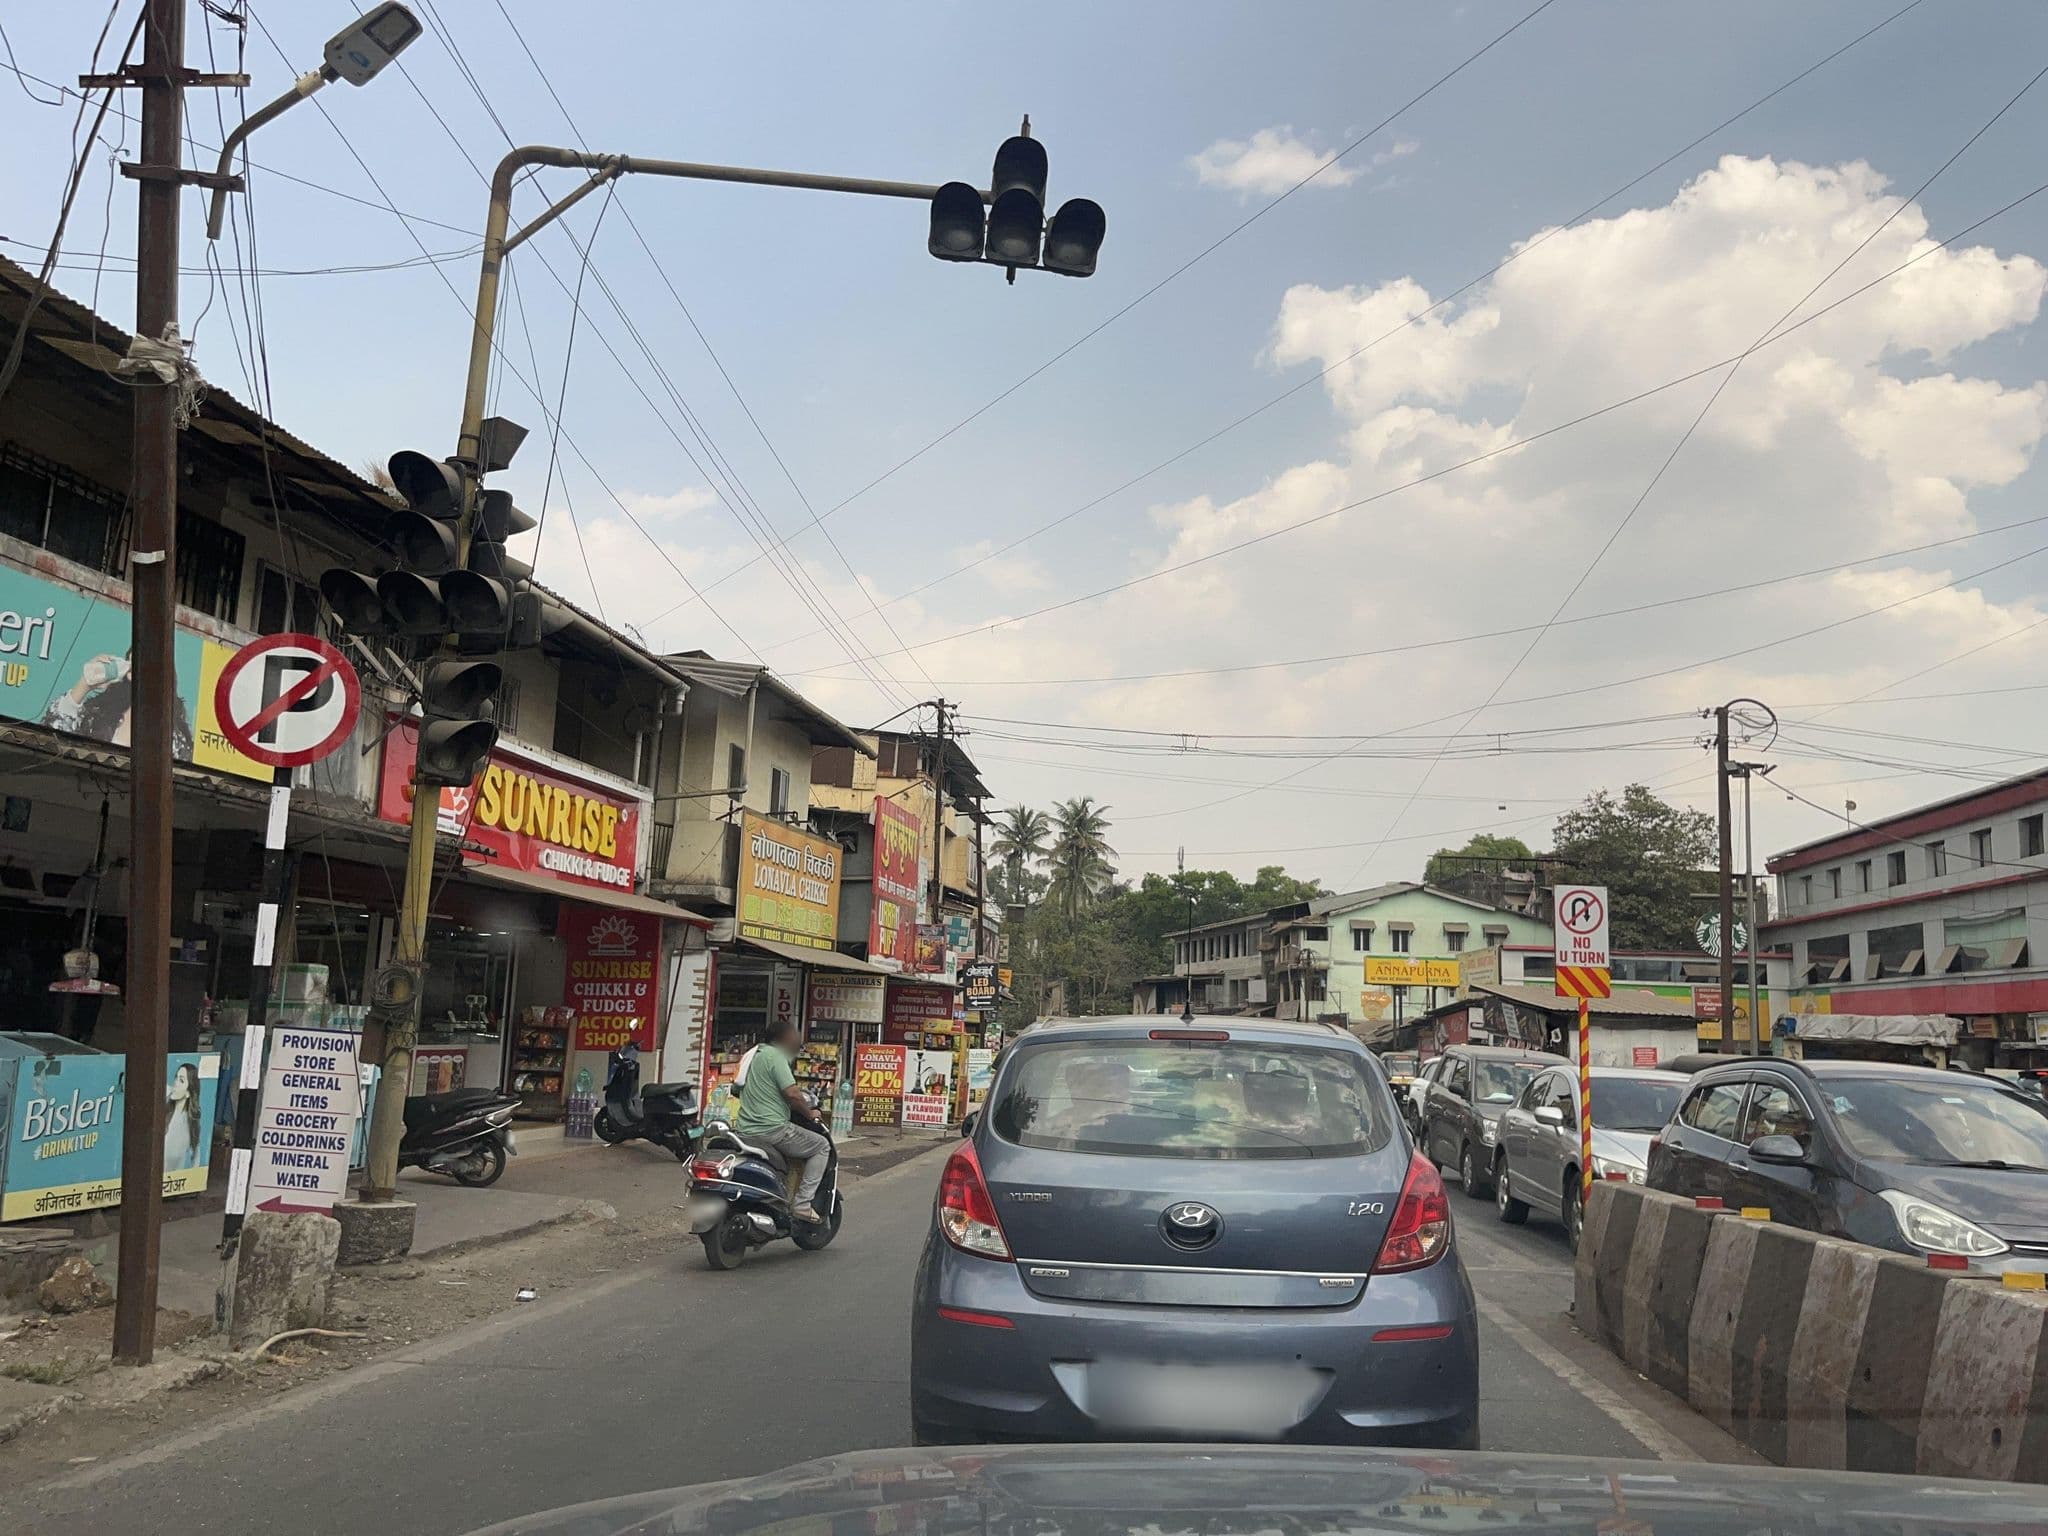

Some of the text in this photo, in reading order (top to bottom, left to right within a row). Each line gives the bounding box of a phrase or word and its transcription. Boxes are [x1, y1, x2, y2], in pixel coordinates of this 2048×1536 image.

[477, 764, 618, 859] SUNRISE
[751, 829, 836, 883] लोणावळा चिक्की
[539, 848, 631, 887] CHIKKI & FUDGE
[753, 863, 830, 907] LONAVLA CHIKKI
[1573, 936, 1591, 949] NO
[1559, 951, 1605, 964] U TURN
[571, 961, 652, 979] SUNRISE
[1375, 966, 1451, 978] ANNAPURNA
[573, 982, 648, 997] CHIKKI &
[972, 978, 989, 988] LED
[966, 987, 996, 997] BOARD
[583, 999, 636, 1013] FUDGE
[812, 1006, 881, 1021] FUDGES
[282, 1034, 354, 1053] PROVISION
[584, 1033, 631, 1046] SHOP
[294, 1055, 336, 1071] STORE
[859, 1054, 902, 1063] LONAVLA
[863, 1062, 898, 1071] CHIKKI
[282, 1073, 342, 1091] GENERAL
[858, 1070, 901, 1089] 20%
[290, 1094, 329, 1109] ITEMS
[912, 1104, 943, 1113] FLAVOUR
[22, 1086, 116, 1142] Bisleri
[276, 1113, 338, 1130] GROCERY
[906, 1113, 943, 1123] AVAILABLE
[262, 1131, 346, 1151] COLDDRINKS
[271, 1152, 329, 1170] MINERAL
[276, 1172, 320, 1188] WATER
[1348, 1201, 1384, 1216] i20
